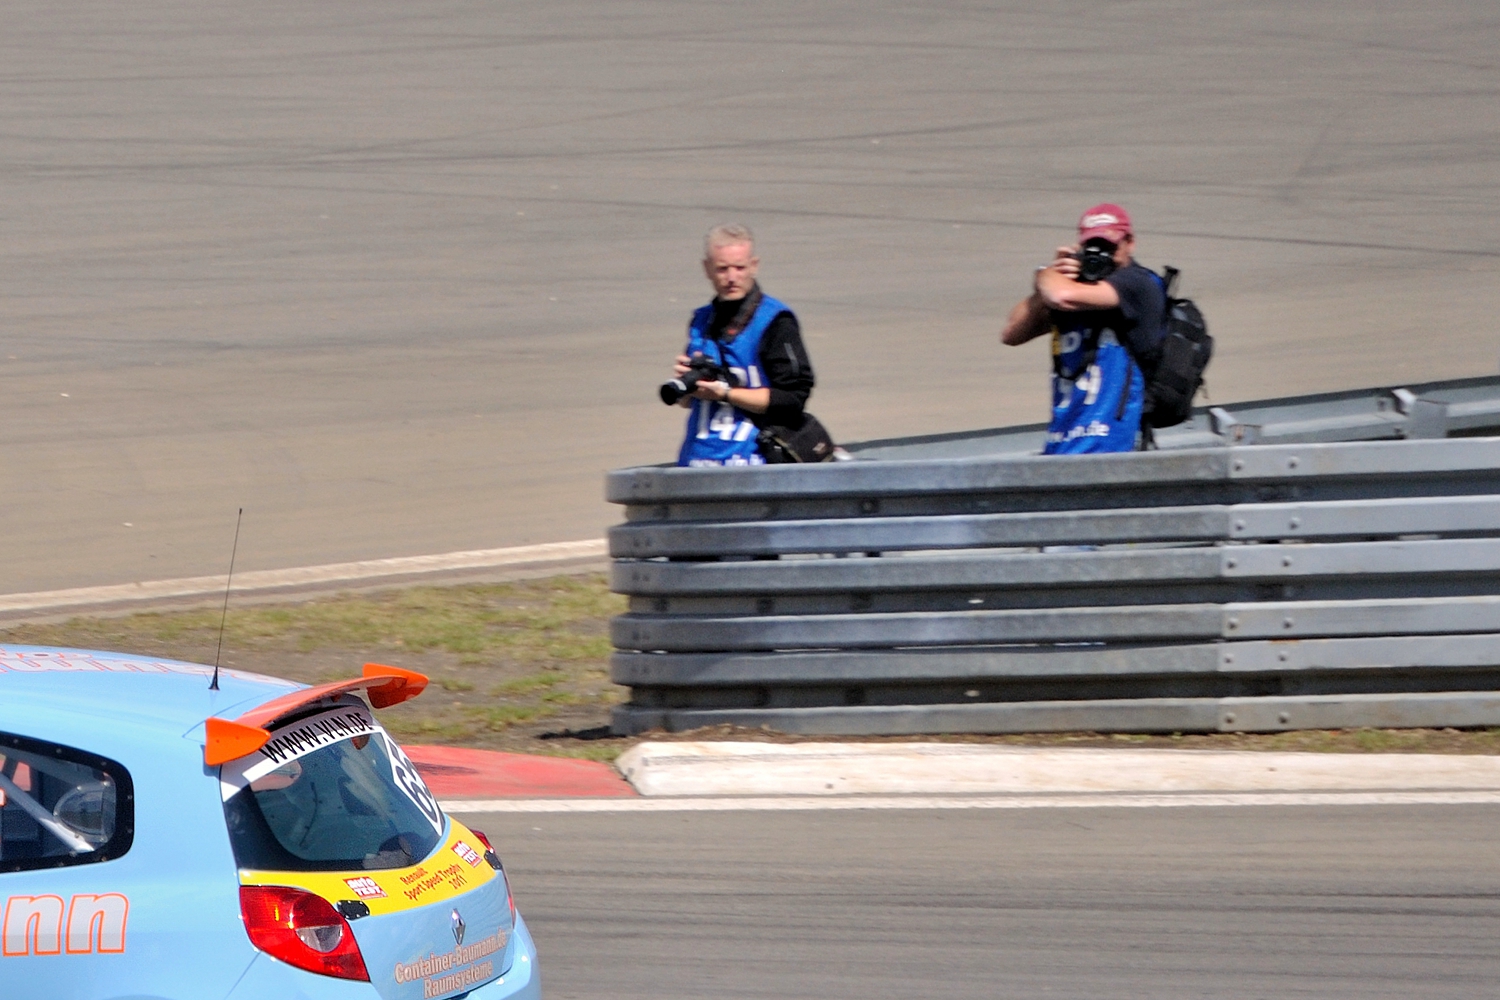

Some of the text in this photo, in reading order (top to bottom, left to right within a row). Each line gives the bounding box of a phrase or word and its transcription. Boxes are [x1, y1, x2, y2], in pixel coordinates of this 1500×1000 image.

[259, 711, 374, 764] WWW.VLN.DE
[403, 883, 427, 901] Sport
[423, 960, 494, 1000] Raumsysteme
